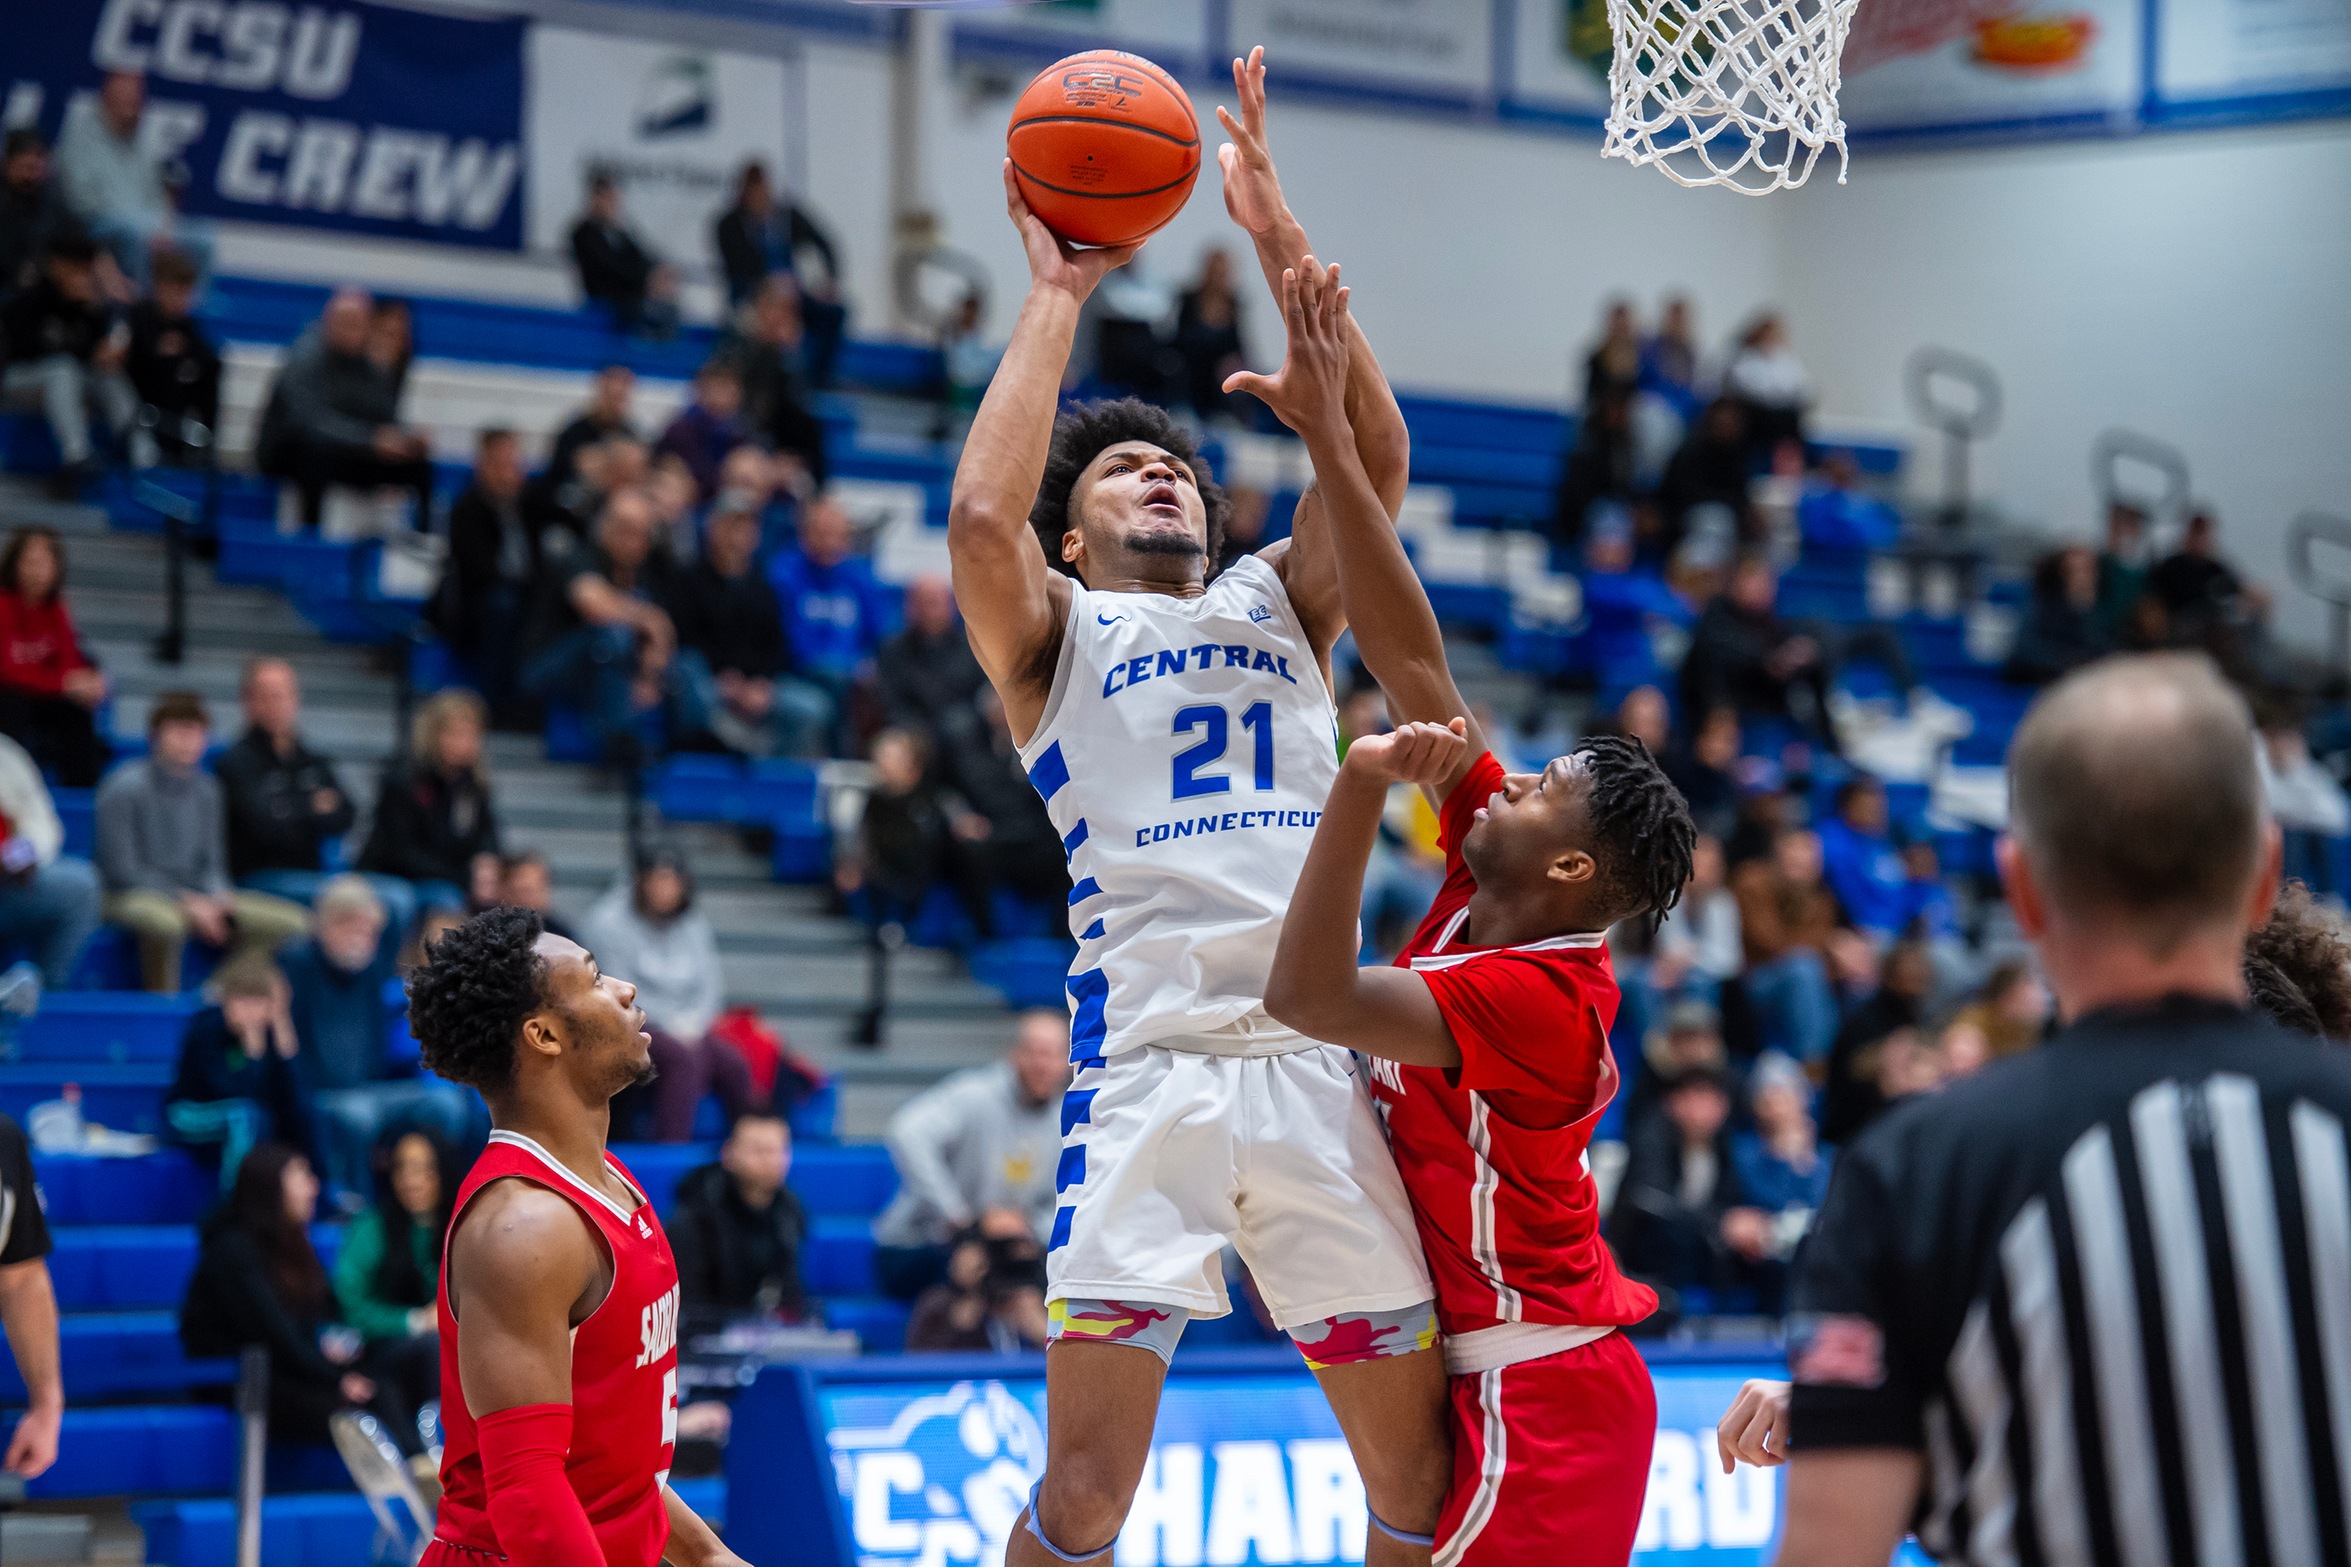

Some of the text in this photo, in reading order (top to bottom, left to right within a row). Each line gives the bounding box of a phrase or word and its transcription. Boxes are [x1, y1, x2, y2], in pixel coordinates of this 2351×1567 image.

[91, 0, 364, 99] CCSU
[213, 106, 518, 232] CREW
[1102, 643, 1297, 699] CENTRAL
[1170, 698, 1275, 804] 21
